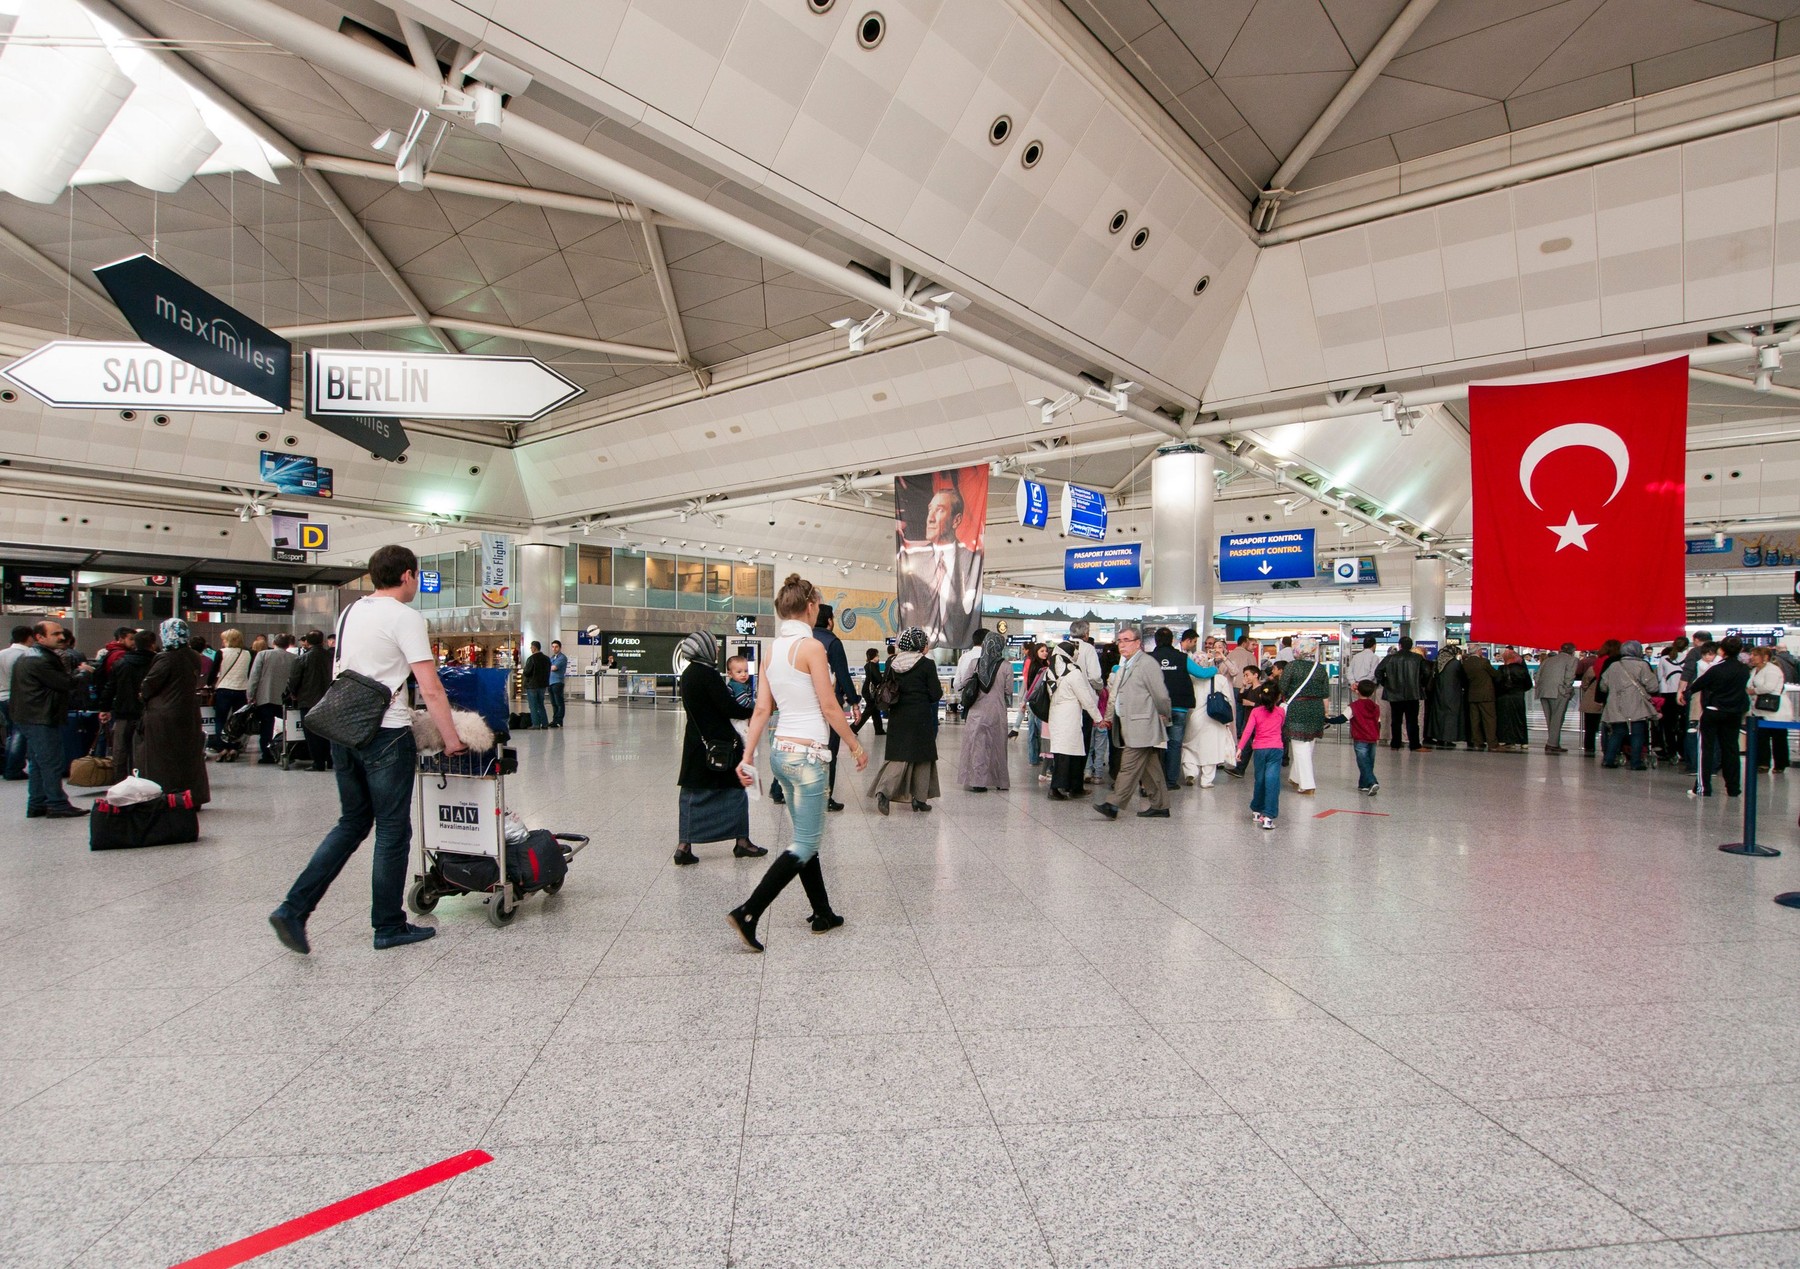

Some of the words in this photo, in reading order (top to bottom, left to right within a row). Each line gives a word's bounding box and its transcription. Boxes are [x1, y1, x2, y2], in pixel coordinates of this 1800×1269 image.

[155, 293, 276, 377] maximiles
[103, 357, 162, 394] SAO
[327, 361, 428, 403] BERLİN
[303, 526, 325, 548] D
[1230, 537, 1267, 546] PASAPORT
[1267, 533, 1303, 543] KONTROL
[492, 541, 506, 565] Flight
[1073, 551, 1104, 559] PASAPORT
[1229, 548, 1265, 557] PASSPORT
[1266, 546, 1302, 555] CONTROL
[1073, 561, 1102, 569] PASSPORT
[1103, 559, 1132, 567] CONTROL
[493, 567, 504, 586] Nice
[609, 637, 640, 645] SHISEIDO
[440, 807, 478, 823] TAV
[439, 823, 479, 831] Havalimanları
